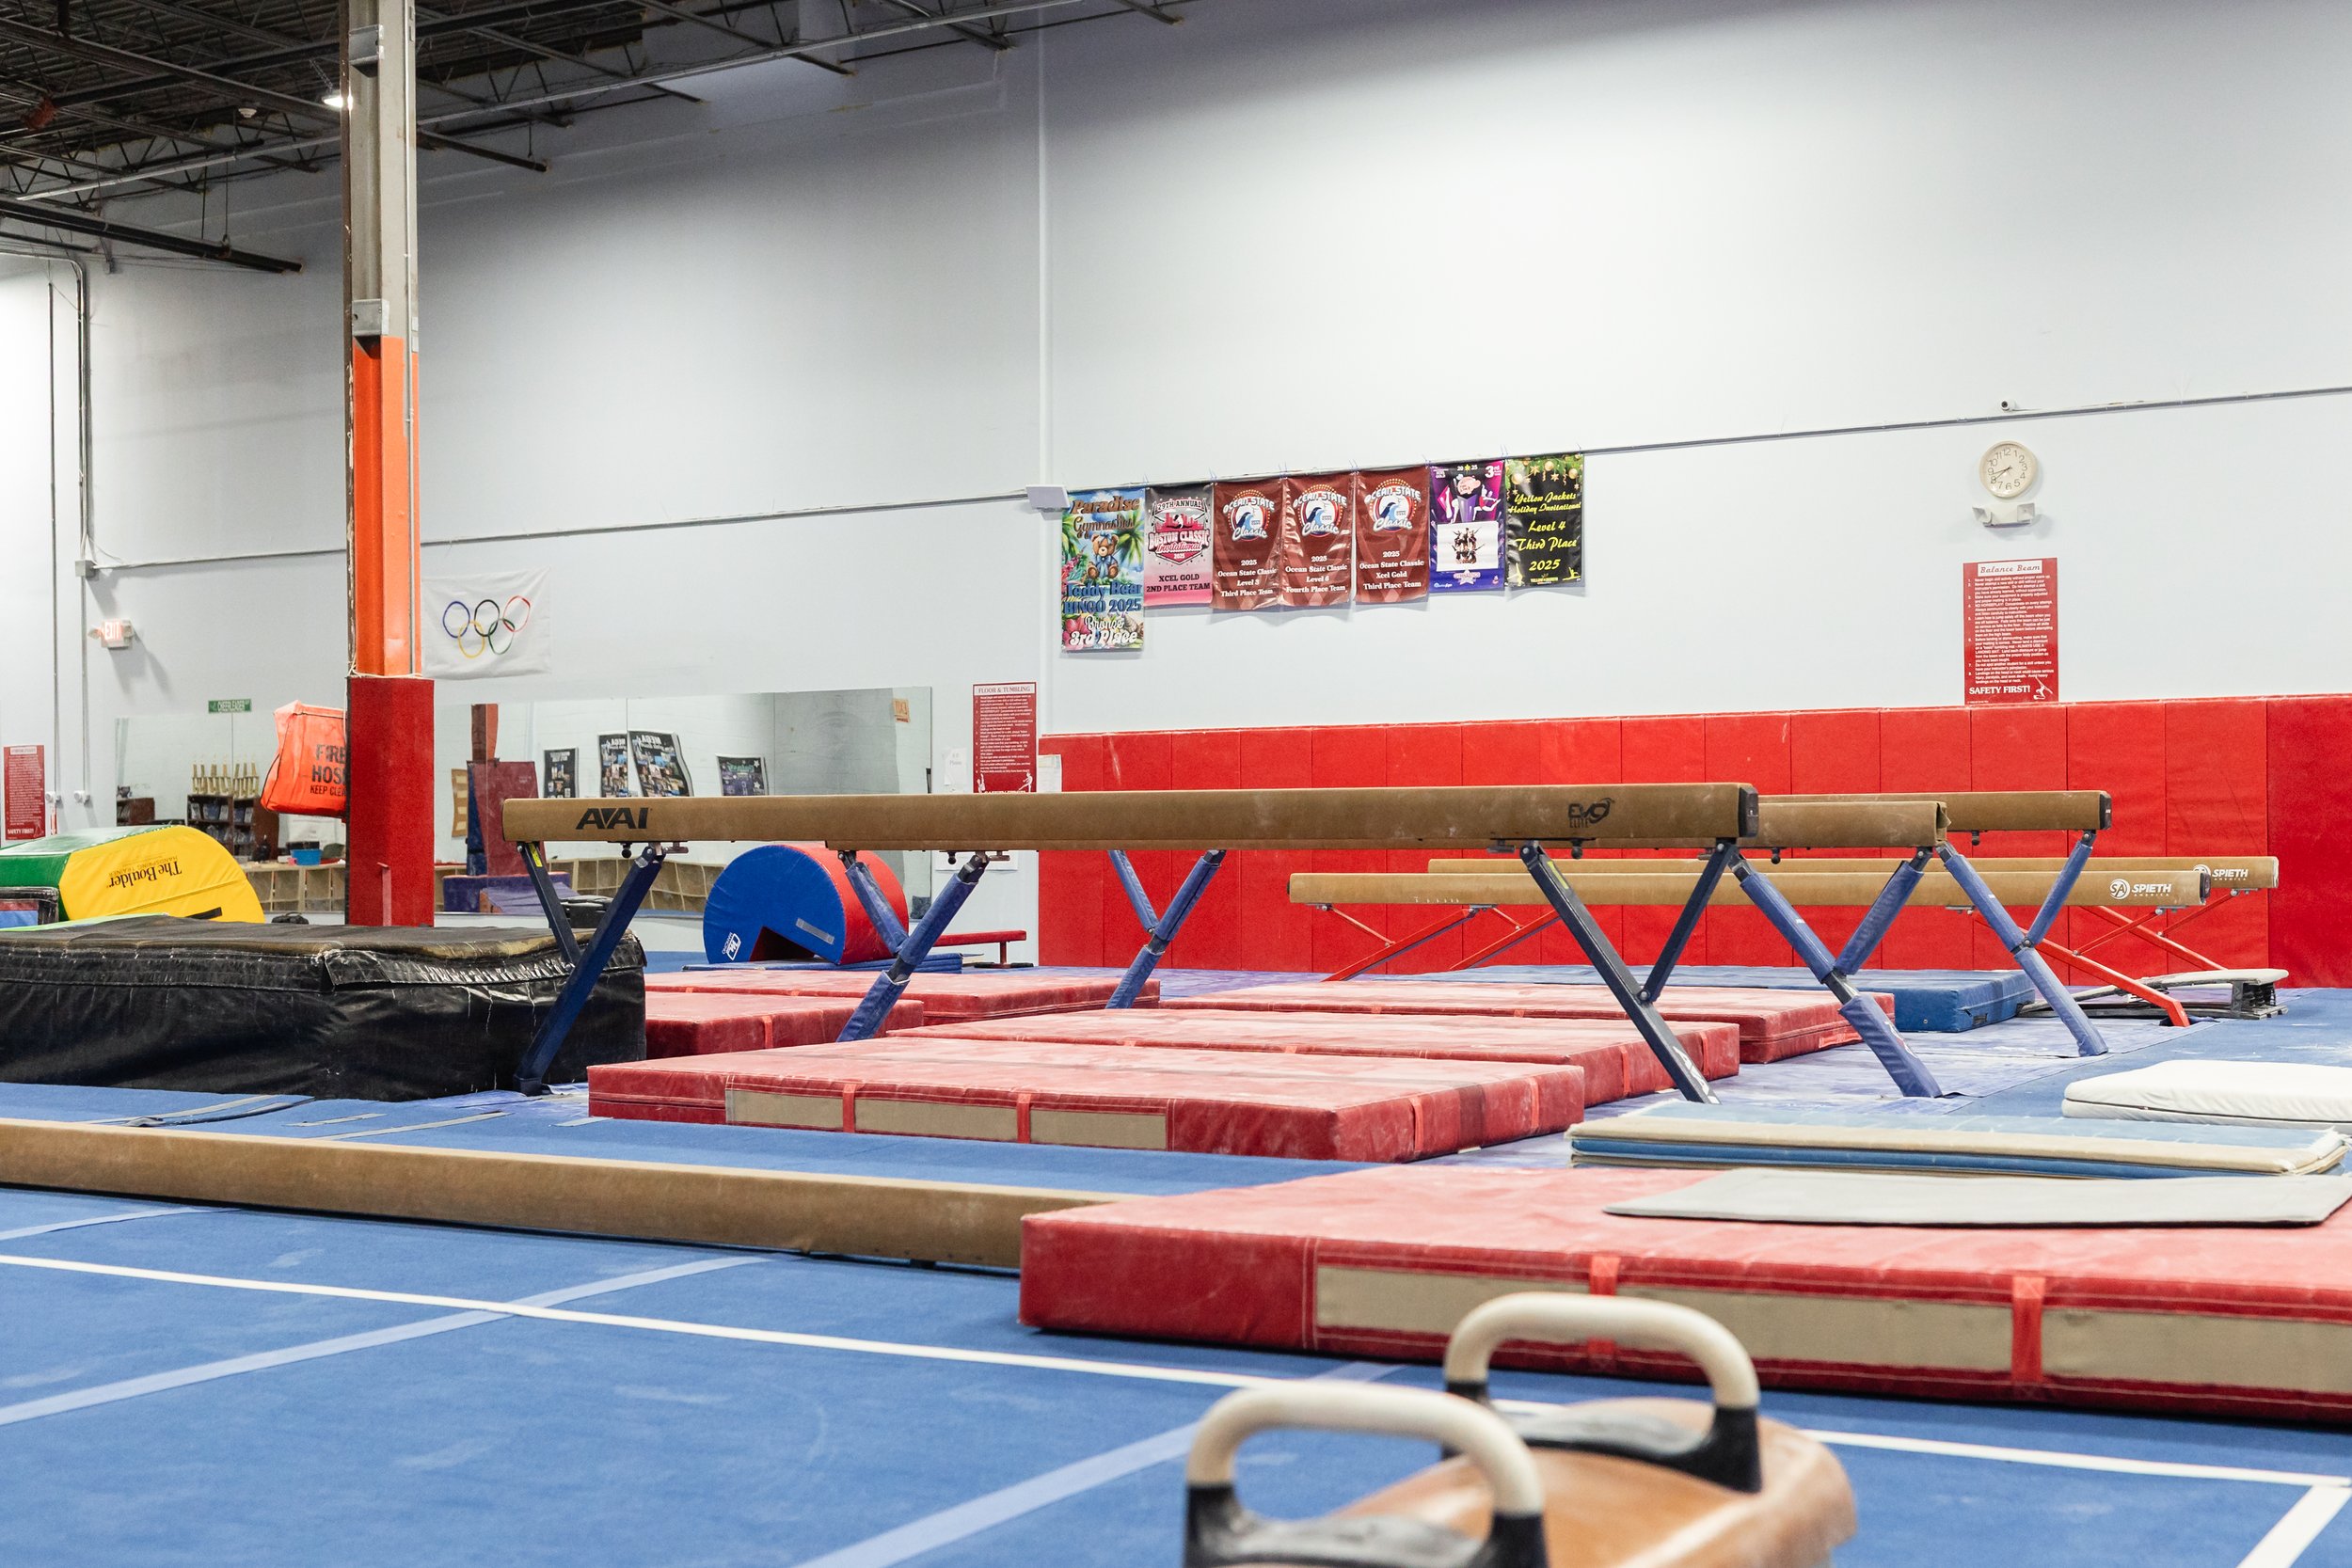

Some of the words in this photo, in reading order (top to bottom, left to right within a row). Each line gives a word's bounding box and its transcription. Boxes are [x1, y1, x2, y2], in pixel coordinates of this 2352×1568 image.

[2022, 463, 2027, 471] 3
[2014, 479, 2020, 487] 5
[1293, 493, 1318, 508] OCEAN
[1321, 492, 1347, 508] STATE
[1364, 486, 1392, 504] OCEAN
[1396, 486, 1421, 502] STATE
[1515, 494, 1543, 504] Yellow
[1545, 491, 1577, 502] Jackets
[1070, 496, 1140, 514] Paradise
[1157, 501, 1174, 510] 29TH
[1223, 497, 1248, 514] OCEAN
[1251, 497, 1275, 511] STATE
[1508, 506, 1537, 515] Holiday
[1538, 502, 1581, 512] Invitational
[1073, 515, 1135, 539] Gymnastics
[1302, 522, 1339, 536] Classic
[1373, 516, 1412, 531] Classic
[1528, 520, 1556, 532] Level
[1558, 521, 1565, 530] 4
[1150, 531, 1178, 549] BOSTON
[1180, 529, 1210, 546] CLASSIC
[1232, 527, 1267, 541] Classic
[1157, 543, 1202, 553] Invitational
[1515, 538, 1546, 551] Third
[1549, 536, 1577, 551] Place
[1529, 559, 1561, 571] 2025
[1067, 582, 1105, 600] Teddy
[1110, 580, 1142, 594] Bear
[1063, 599, 1106, 614] BINGO
[1109, 598, 1142, 612] 2025
[1086, 614, 1125, 630] Bronze
[104, 622, 120, 640] EXIT
[1070, 628, 1096, 646] 3rd
[1098, 629, 1138, 645] Place
[2003, 685, 2030, 693] FIRST!
[316, 744, 347, 764] FIRE
[310, 784, 327, 794] KEEP
[158, 862, 183, 876] The
[109, 866, 157, 888] Boulder
[2132, 884, 2171, 893] SPIETH
